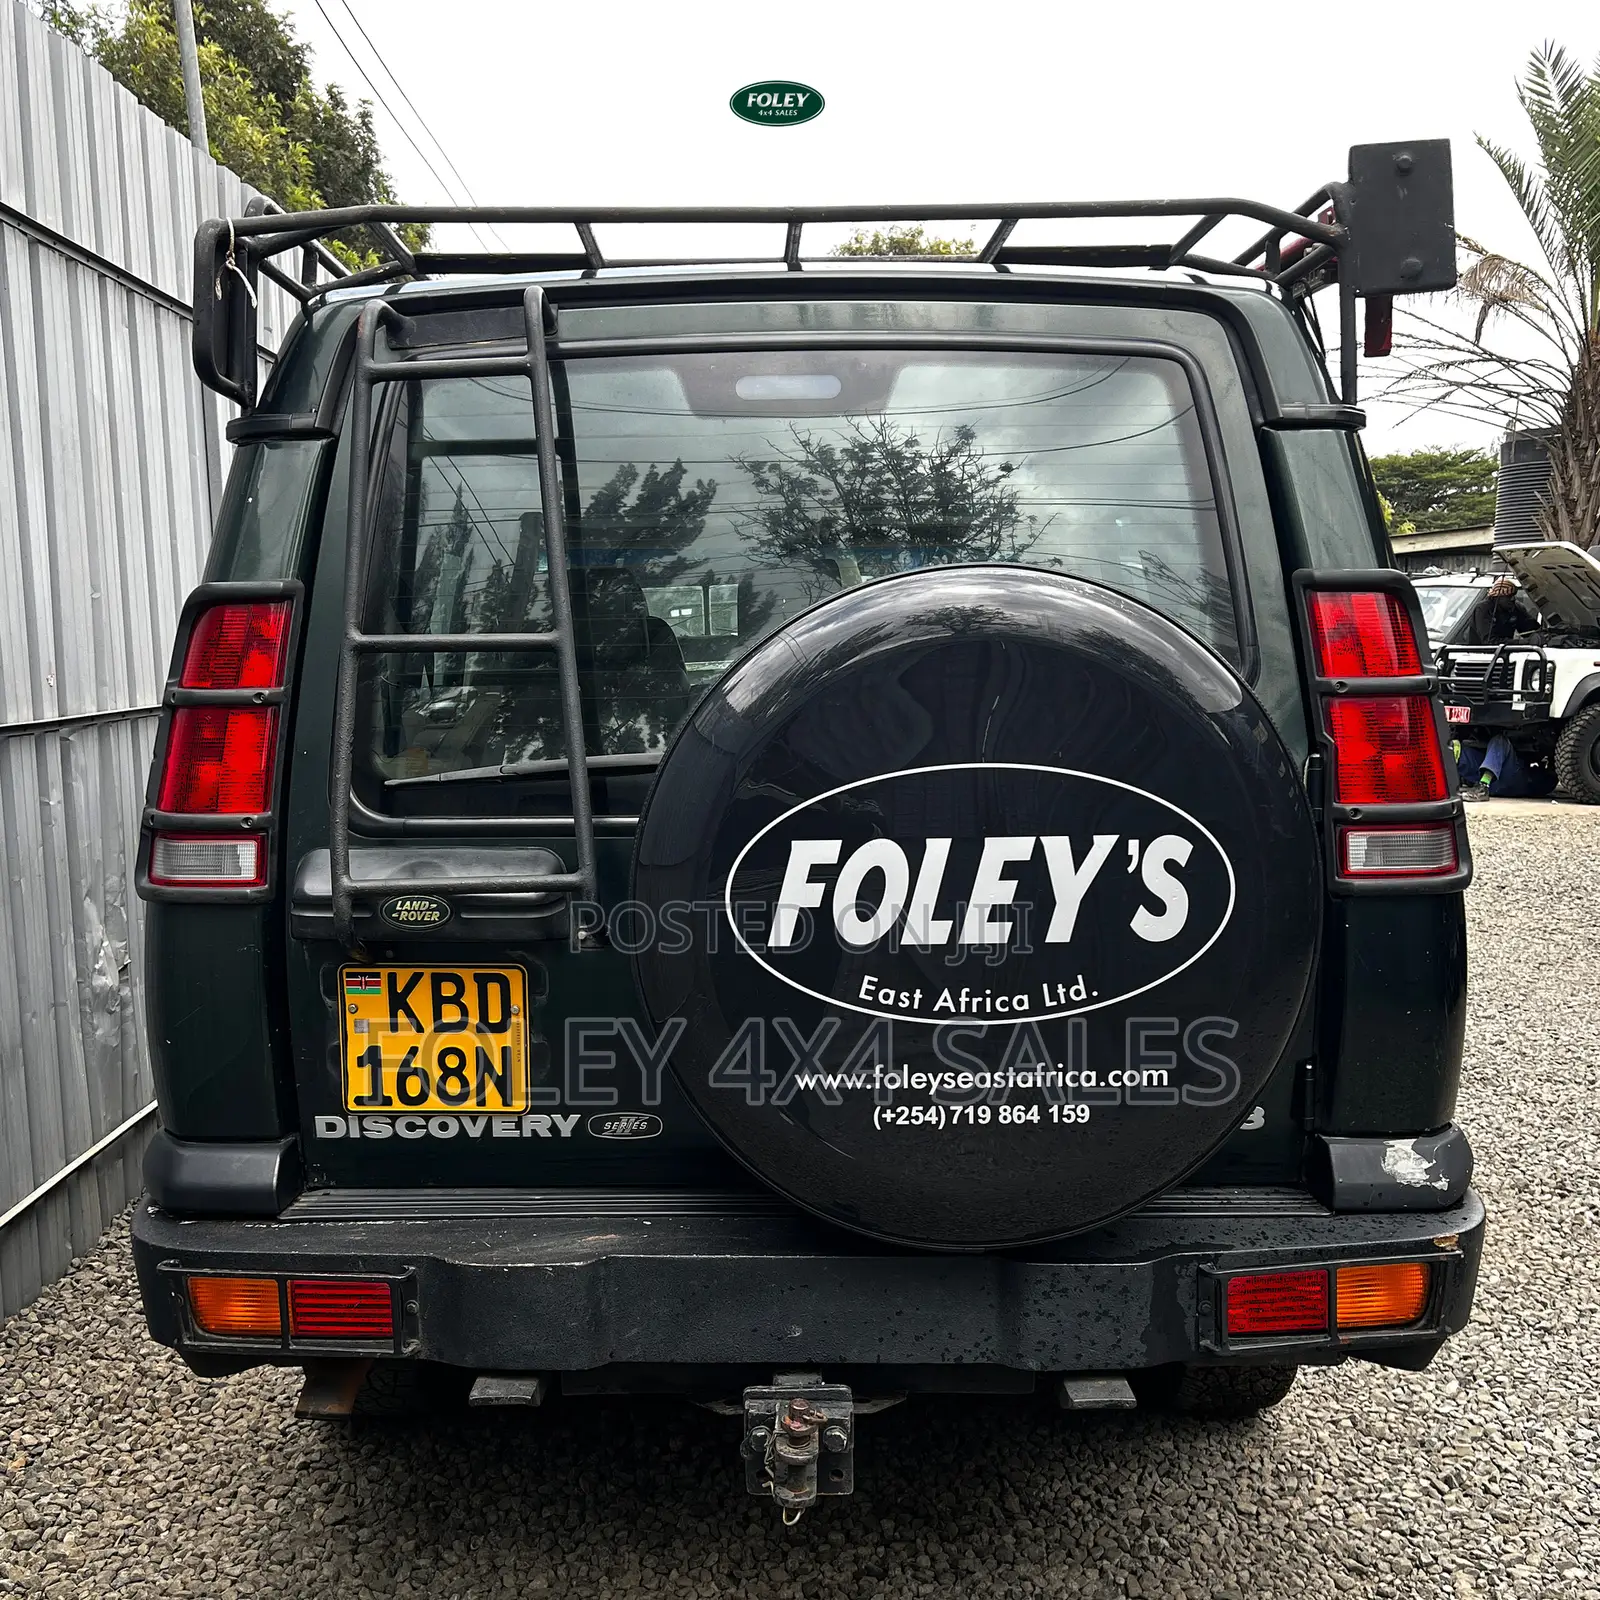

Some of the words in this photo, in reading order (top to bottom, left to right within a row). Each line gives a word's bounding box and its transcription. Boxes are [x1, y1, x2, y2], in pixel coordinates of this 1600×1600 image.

[395, 900, 430, 911] LAND
[767, 834, 1194, 948] FOLEY'S
[399, 911, 440, 921] ROVER
[386, 971, 512, 1034] KBD
[859, 974, 923, 1010] East
[932, 987, 1030, 1013] Africa
[1042, 974, 1099, 1007] Ltd.
[354, 1045, 513, 1108] 168N
[795, 1063, 1169, 1096] www.foleyseastafrica.com
[314, 1114, 581, 1139] DISCOVERY
[603, 1122, 648, 1130] SERIES
[873, 1106, 946, 1130] (+254)
[949, 1105, 991, 1125] 719
[998, 1105, 1040, 1124] 864
[1048, 1104, 1090, 1123] 159
